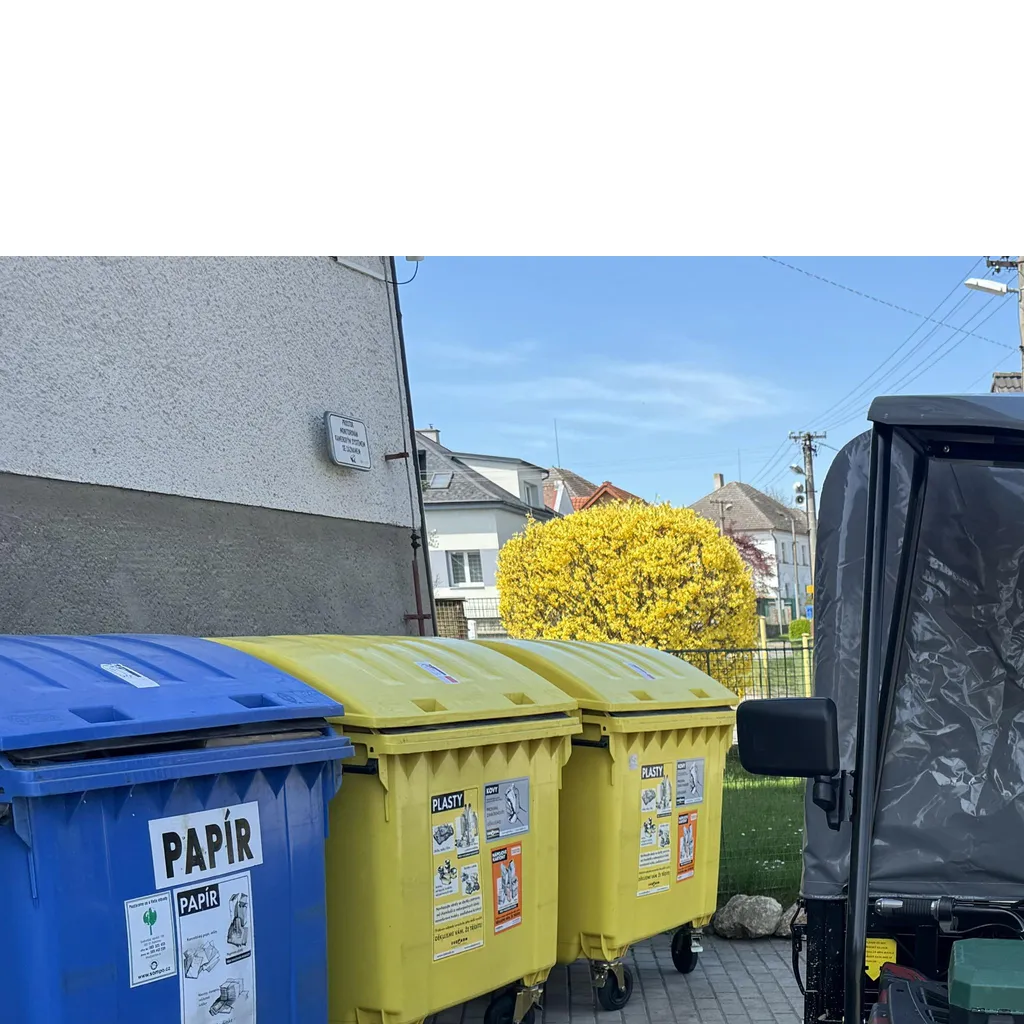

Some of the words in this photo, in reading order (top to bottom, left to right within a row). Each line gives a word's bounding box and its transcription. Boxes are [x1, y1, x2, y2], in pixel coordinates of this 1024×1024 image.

[641, 765, 663, 779] PLASTY
[486, 785, 499, 794] KOVY
[432, 793, 463, 812] PLASTY
[162, 808, 254, 879] PAPÍR
[180, 887, 218, 914] PAPÍR
